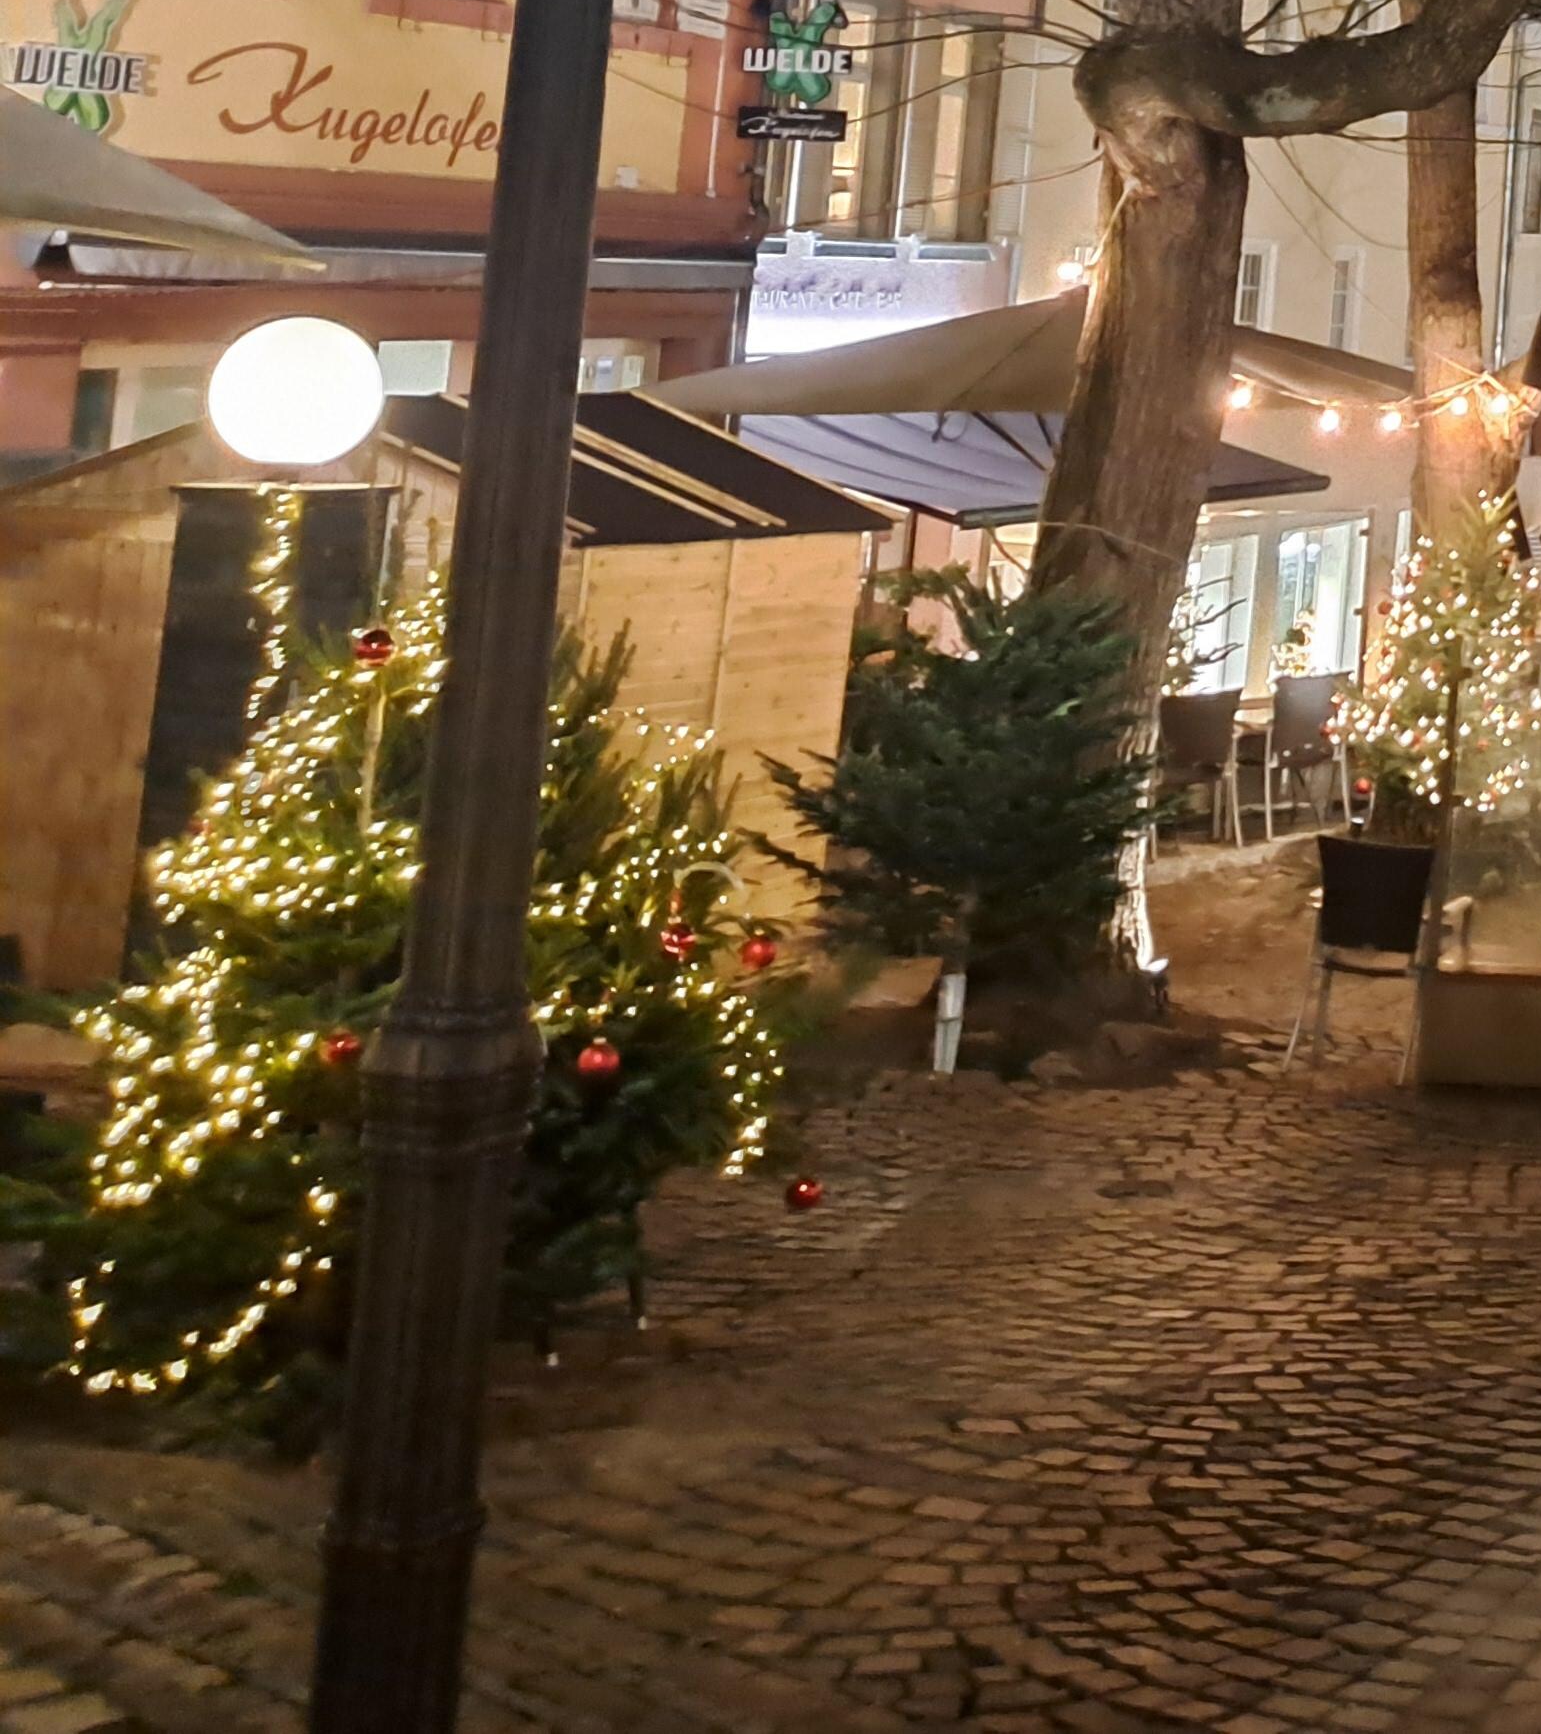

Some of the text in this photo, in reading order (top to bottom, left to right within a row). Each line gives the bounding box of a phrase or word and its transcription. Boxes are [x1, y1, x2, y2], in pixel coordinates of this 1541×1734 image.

[14, 45, 146, 95] WELDE
[742, 47, 850, 74] WELDE
[187, 41, 501, 166] Kugelofe
